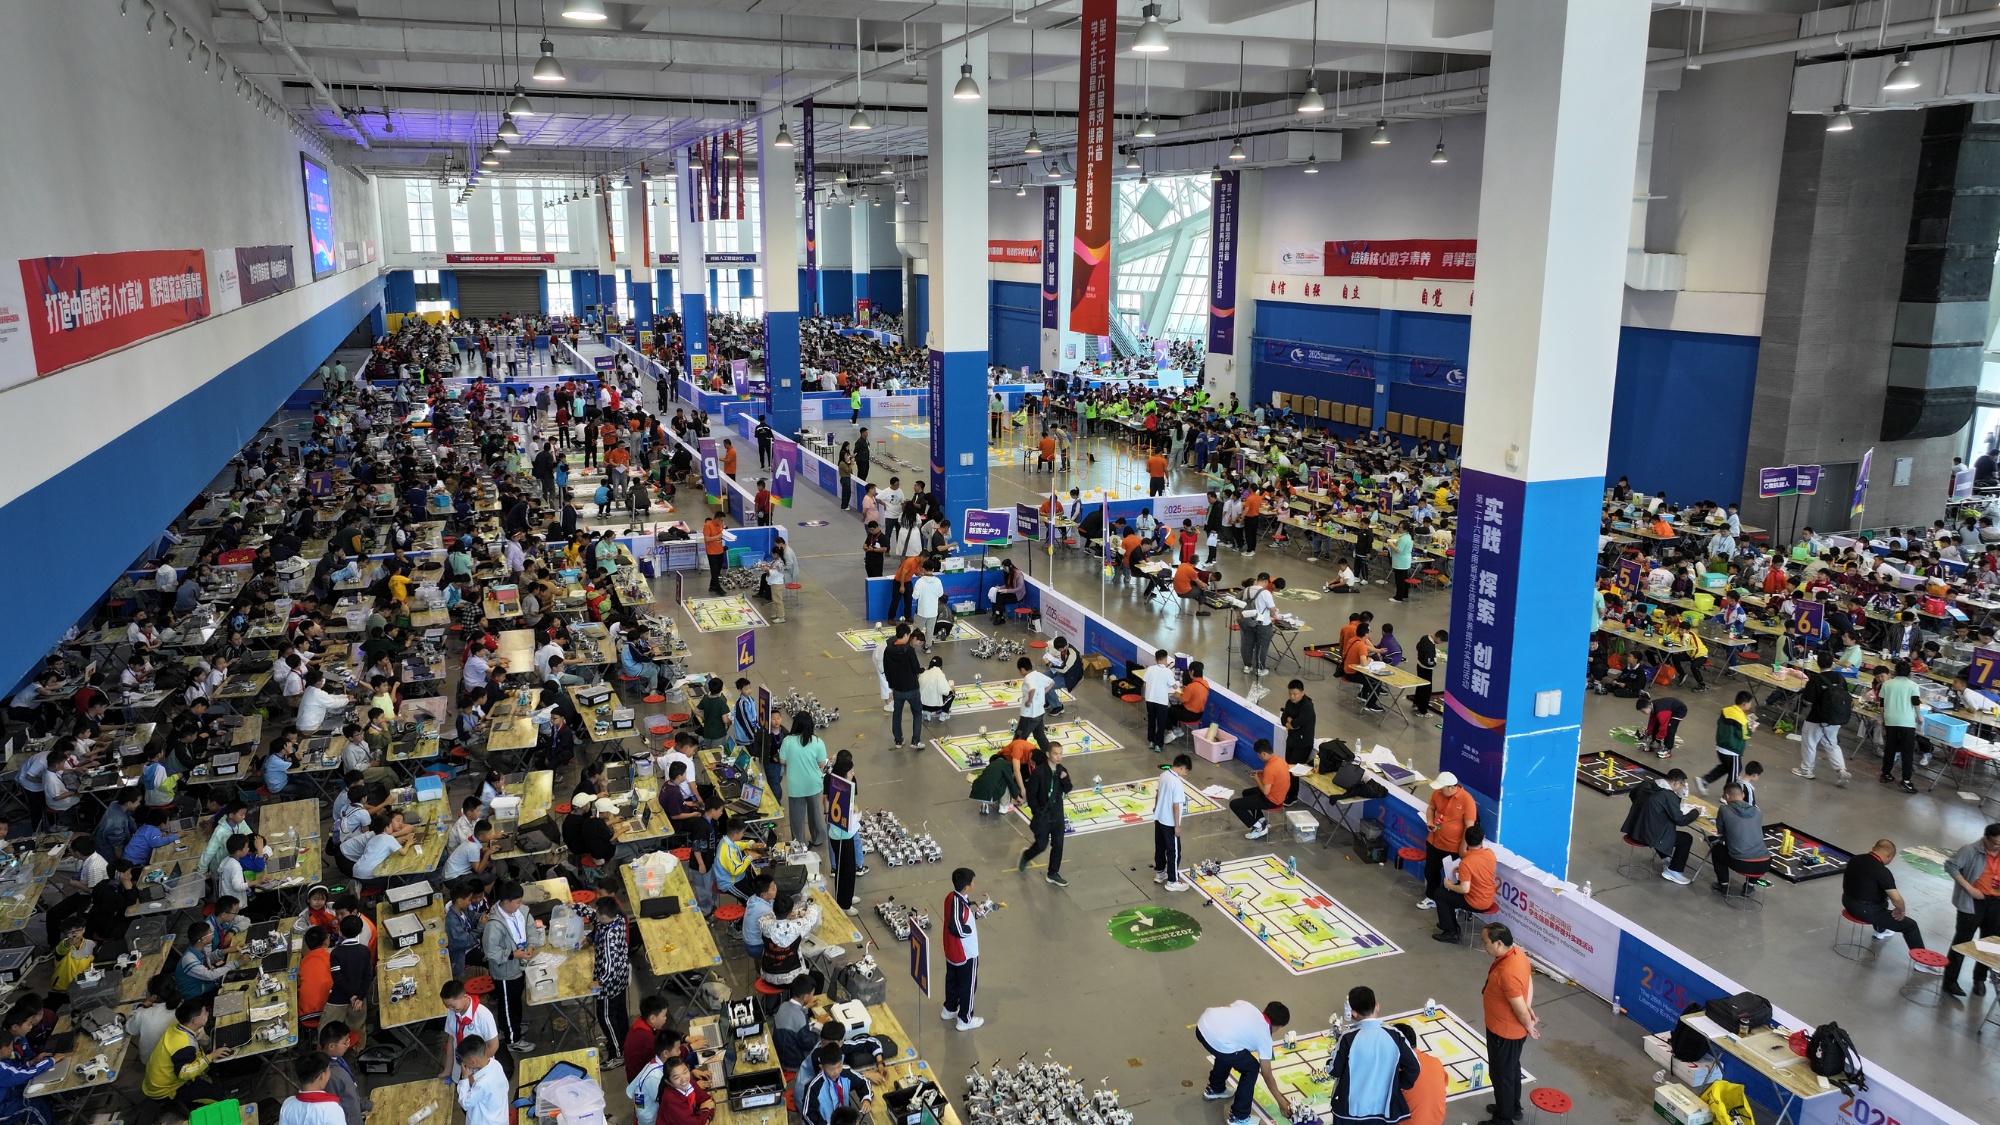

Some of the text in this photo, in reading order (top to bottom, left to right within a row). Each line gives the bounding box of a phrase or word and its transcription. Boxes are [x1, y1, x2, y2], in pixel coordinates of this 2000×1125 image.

[1085, 20, 1098, 230] 学生信息素养提升实践活动
[1350, 252, 1431, 267] 培铸核心数字素养
[45, 278, 144, 335] 打造中原数字人才高地
[149, 272, 202, 307] 服务国家高质量发展
[1270, 280, 1443, 307] 自信 自强 自立 自觉
[775, 458, 791, 482] A
[1164, 505, 1182, 514] 2025
[1471, 498, 1504, 698] 实践 探索 创新
[1494, 877, 1528, 911] 2025
[1524, 915, 1543, 932] Province
[1543, 926, 1560, 942] Student
[1529, 900, 1572, 932] 第二十六届河南省
[1528, 908, 1594, 954] 学生信息素养提升实践活动
[1536, 930, 1556, 947] Program
[1640, 988, 1650, 999] The
[1641, 966, 1686, 1009] 2025
[1639, 995, 1660, 1013] Literacy
[1839, 1097, 1902, 1125] 202
